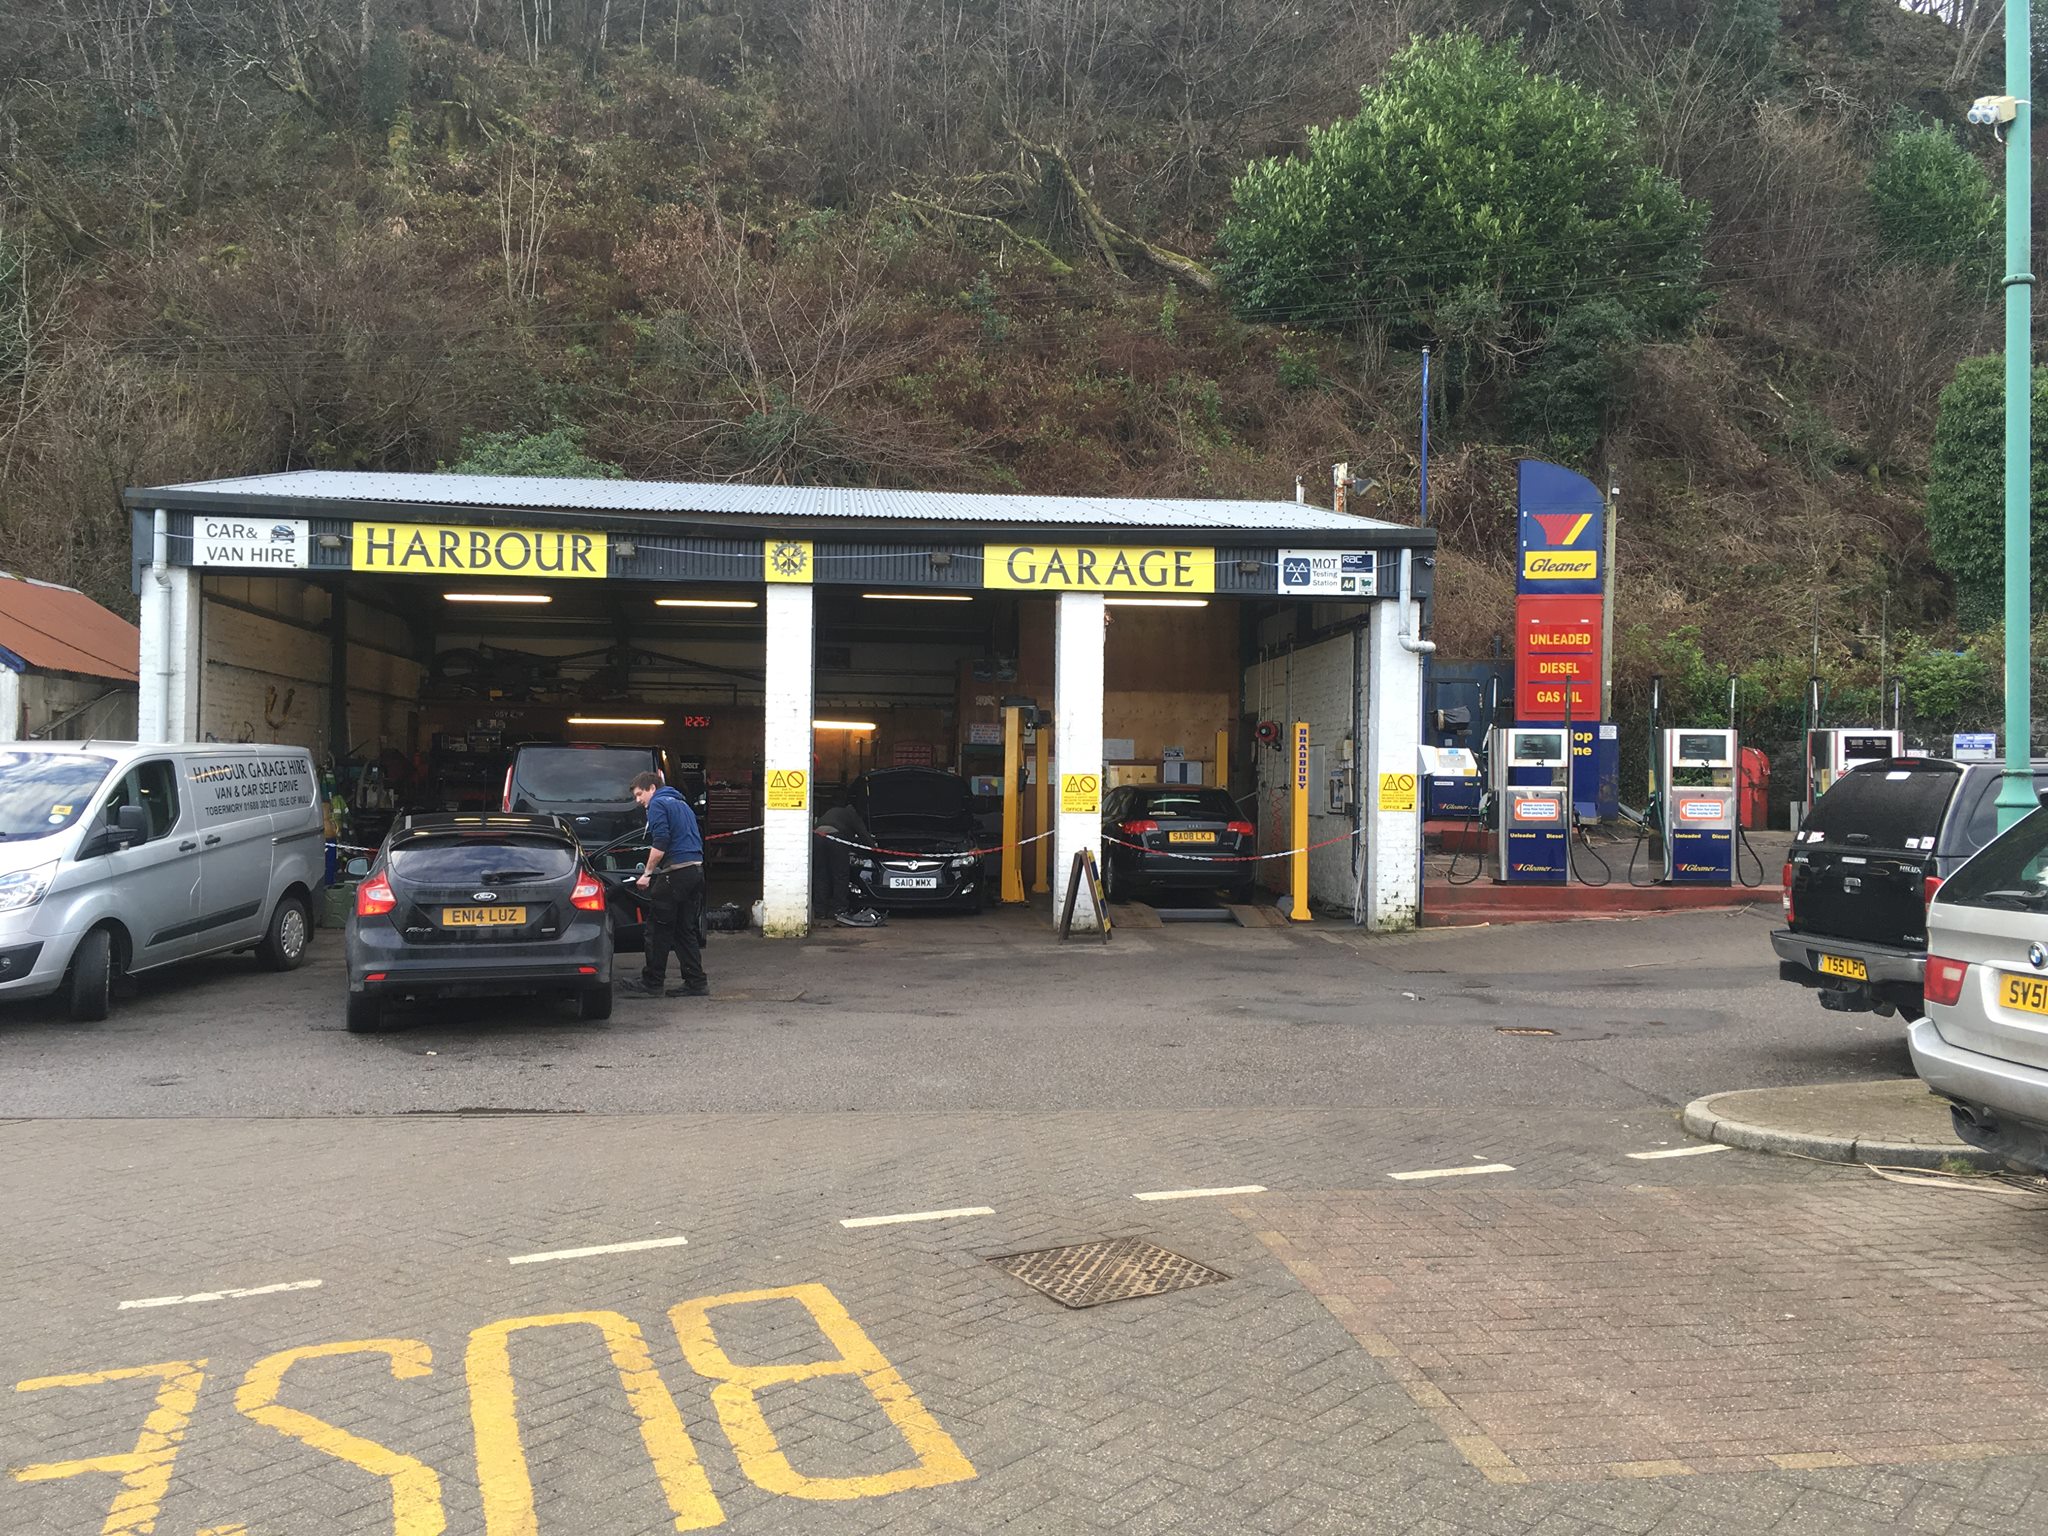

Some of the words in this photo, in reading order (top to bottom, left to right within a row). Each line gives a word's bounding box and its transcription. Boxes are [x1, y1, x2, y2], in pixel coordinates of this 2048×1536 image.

[206, 545, 245, 562] VAN
[250, 546, 296, 564] HIRE
[365, 526, 597, 572] HARBOUR
[1006, 547, 1194, 587] GARAGE
[1312, 558, 1338, 569] MOT
[1529, 558, 1592, 573] Gleaner
[1312, 570, 1338, 580] Testing
[1312, 579, 1338, 587] Station
[1529, 633, 1591, 646] UNLEADED
[1539, 662, 1580, 674] DIESEL
[1536, 691, 1561, 703] GAS
[193, 763, 248, 784] HARBOUR
[248, 760, 288, 779] GARAGE
[288, 759, 307, 775] HIRE
[214, 787, 233, 800] VAN
[234, 787, 240, 797] &
[241, 784, 258, 797] CAR
[259, 782, 278, 795] SELF
[279, 779, 299, 793] DRIVE
[205, 801, 243, 817] TOBERMORY
[1172, 832, 1194, 841] SA08
[1195, 832, 1212, 841] LKJ
[895, 878, 914, 888] SA10
[915, 878, 933, 888] WMX
[451, 910, 485, 923] EN14
[489, 909, 518, 922] LUZ
[1827, 956, 1845, 973] T55
[1846, 959, 1865, 977] LPG
